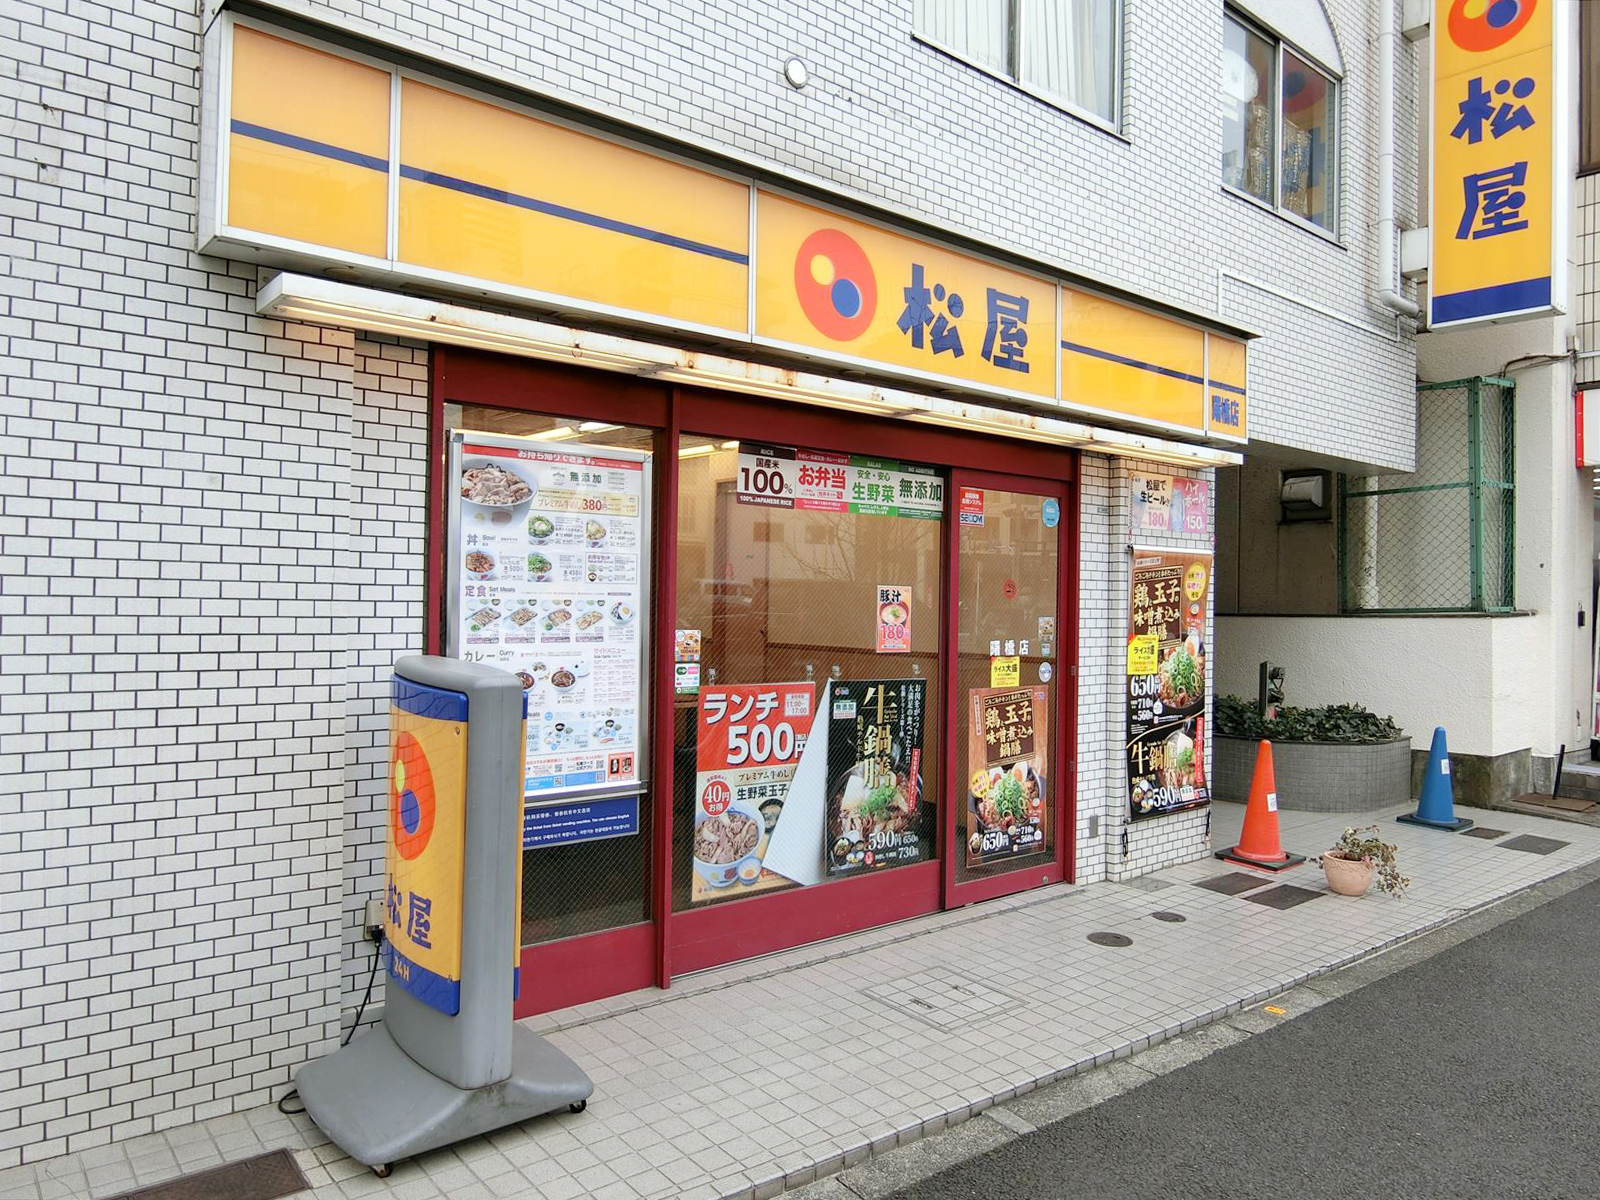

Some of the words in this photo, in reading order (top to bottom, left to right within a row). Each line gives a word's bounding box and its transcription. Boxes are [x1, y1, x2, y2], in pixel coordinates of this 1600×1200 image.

[1450, 77, 1535, 240] 松屋
[896, 263, 1029, 374] 松屋
[756, 457, 779, 469] 国産米
[570, 471, 602, 484] 無添加
[741, 467, 793, 495] 100%
[799, 465, 846, 490] お弁当
[857, 469, 891, 482] 安全・安心
[1146, 479, 1167, 491] 松屋で
[852, 482, 895, 503] 生野菜
[899, 478, 942, 502] 無添加
[1185, 482, 1199, 496] ハイ
[754, 497, 780, 505] JAPANESE
[960, 513, 983, 523] SECOM
[466, 534, 478, 546] 丼
[465, 585, 487, 597] 定食
[880, 589, 901, 602] 豚汁
[1134, 579, 1181, 608] 鶏と玉子の
[1134, 606, 1181, 627] 味噌煮込み
[464, 650, 496, 662] カレー
[994, 664, 1018, 673] ライス大盛
[1130, 674, 1160, 696] 650円
[703, 691, 779, 724] ランチ
[985, 701, 1032, 729] 鶏と玉子の
[861, 684, 897, 789] 牛鍋膳
[986, 724, 1034, 745] 味噌煮込み
[999, 740, 1022, 758] 鍋膳
[704, 784, 730, 803] 40円
[737, 784, 790, 800] 生野菜玉子
[1153, 786, 1181, 808] 590円
[709, 803, 723, 812] お得
[868, 829, 901, 851] 590円
[983, 831, 1009, 851] 650円
[387, 873, 432, 950] 松屋
[393, 957, 410, 982] 24H
